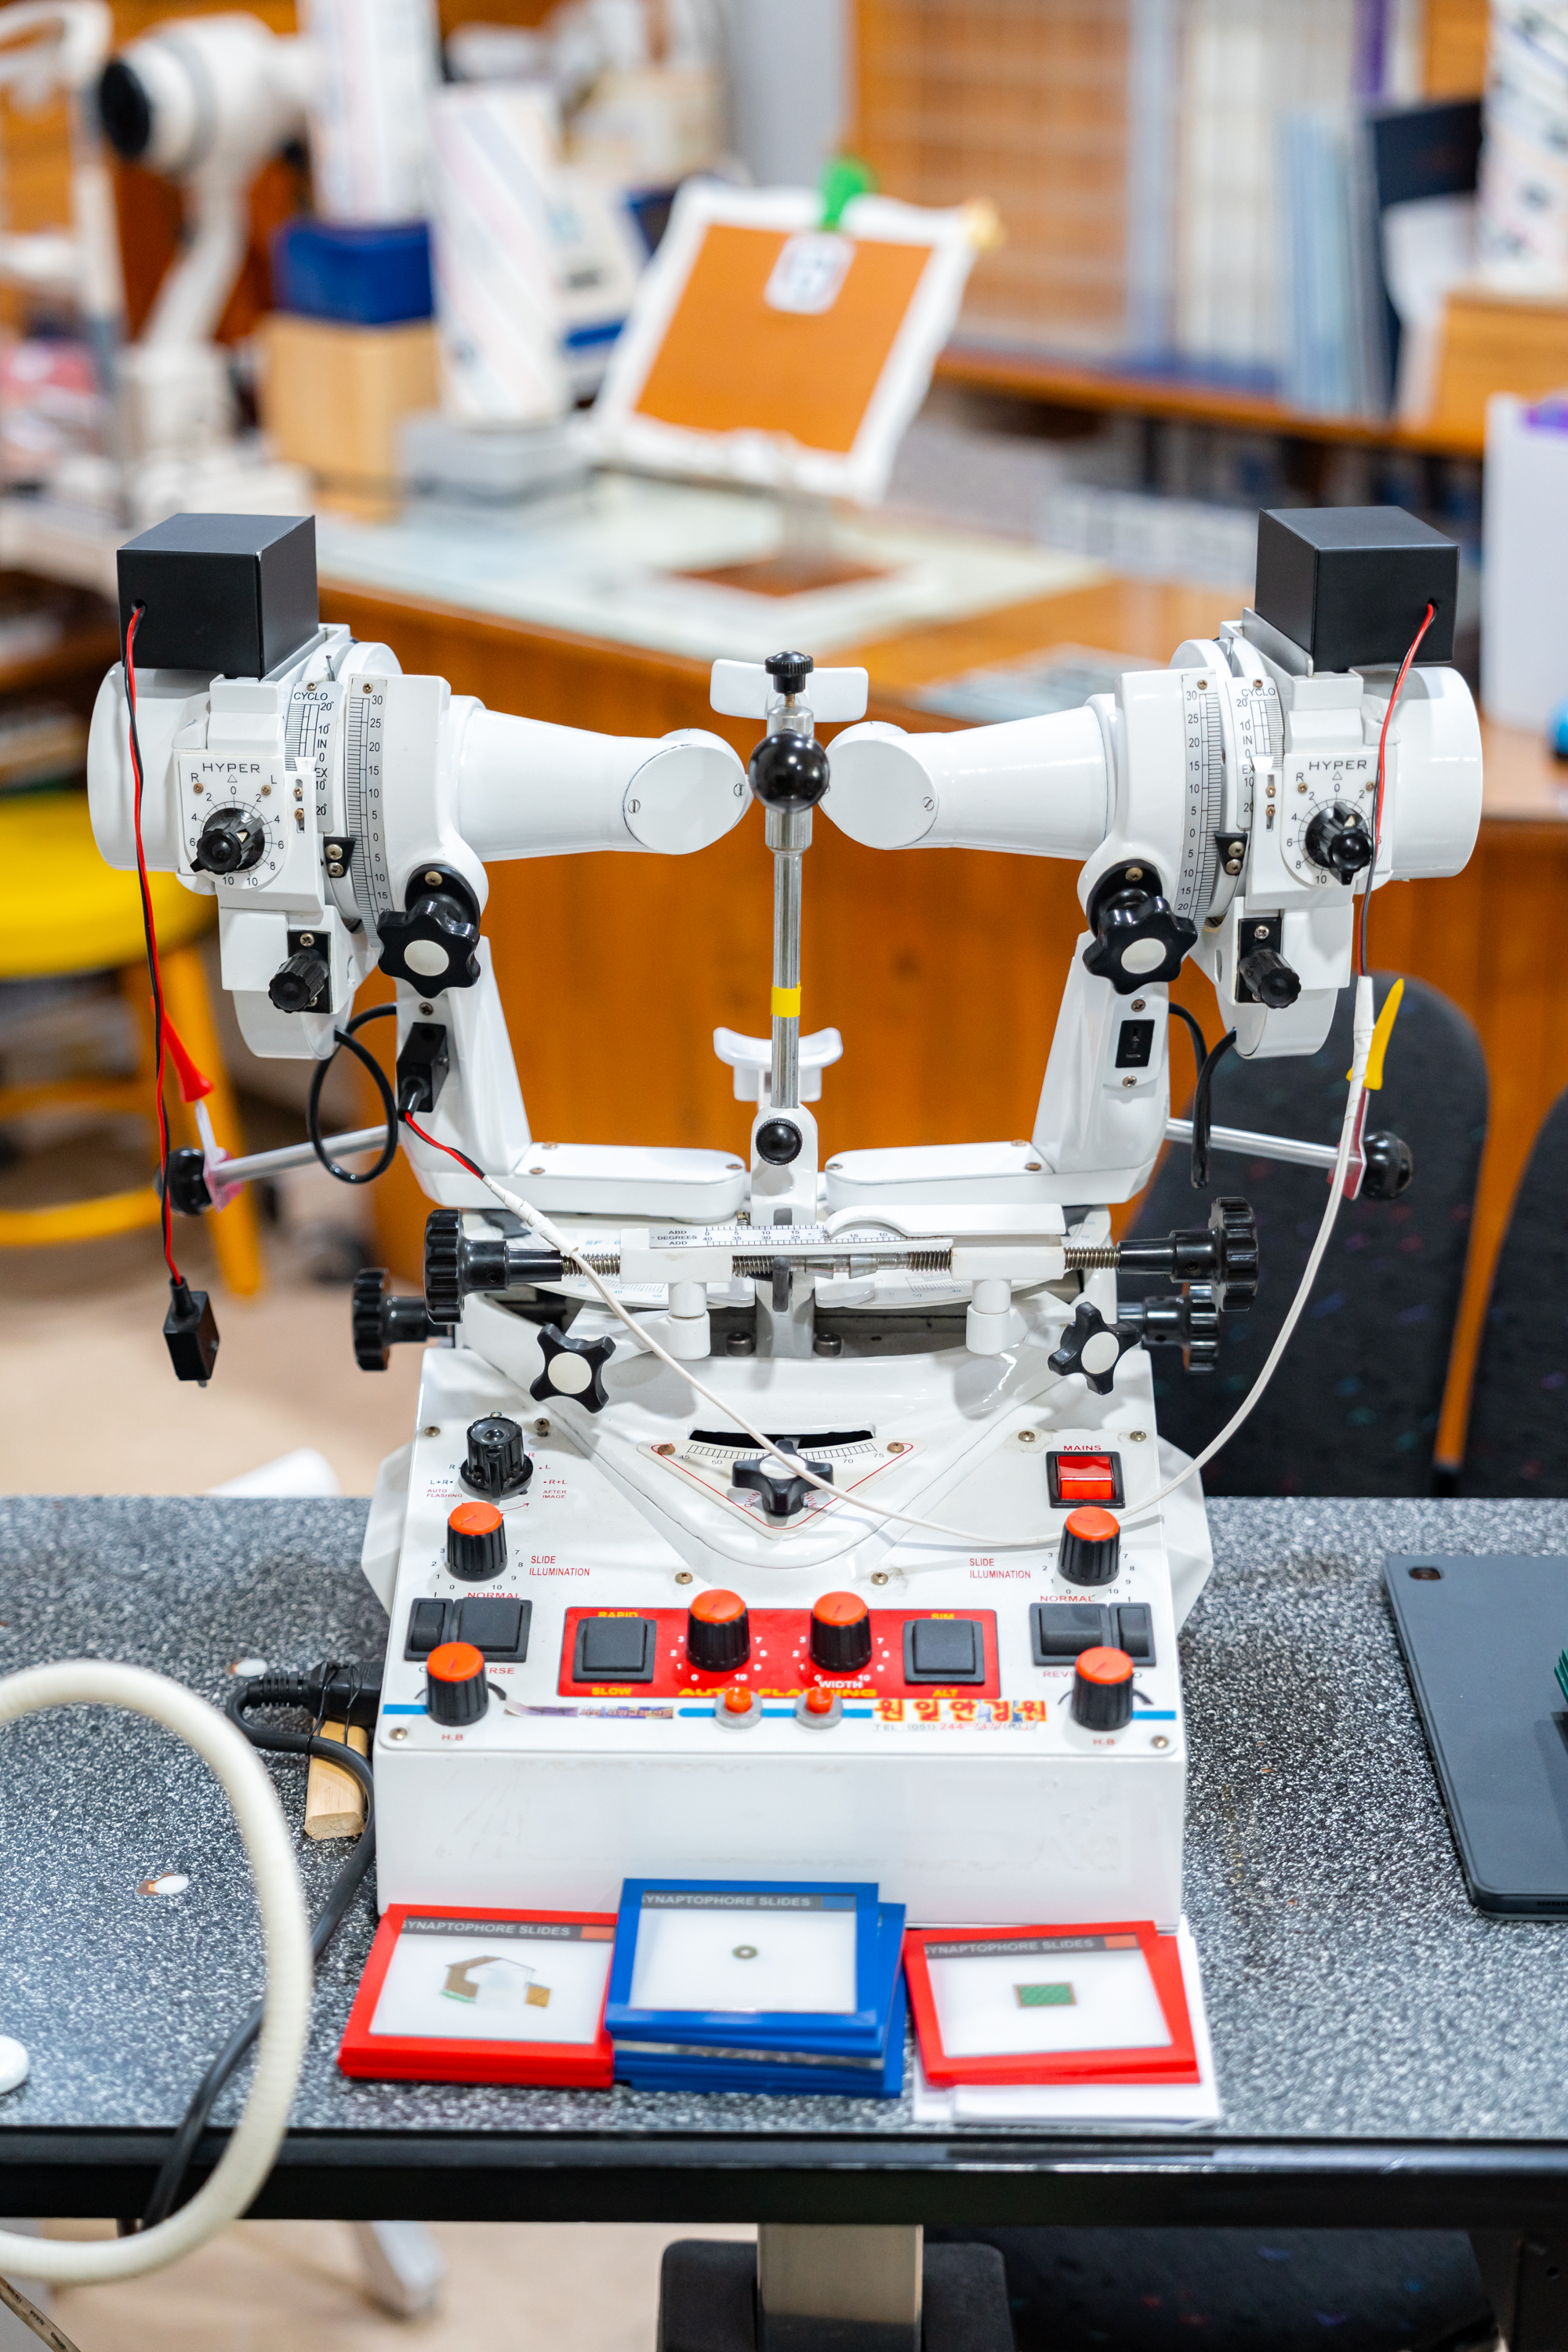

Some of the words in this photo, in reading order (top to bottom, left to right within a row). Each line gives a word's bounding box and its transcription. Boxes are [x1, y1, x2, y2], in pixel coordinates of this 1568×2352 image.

[293, 691, 328, 701] CYCLO
[1186, 691, 1196, 701] 30
[1241, 688, 1276, 698] CYCLO
[372, 695, 383, 705] 30
[369, 718, 381, 728] 25
[1188, 713, 1199, 724] 25
[317, 739, 327, 749] IN
[1189, 738, 1200, 747] 20
[1243, 735, 1252, 746] IN
[368, 742, 380, 752] 20
[319, 753, 325, 762] 0
[1245, 749, 1250, 758] 0
[202, 763, 260, 773] HYPER
[1189, 761, 1200, 771] 15
[1242, 764, 1255, 774] EX
[1309, 760, 1367, 771] HYPER
[315, 768, 328, 778] EX
[368, 766, 379, 775] 15
[191, 773, 199, 783] R
[270, 775, 278, 784] L
[1296, 772, 1304, 782] R
[230, 786, 237, 796] 0
[1189, 784, 1200, 793] 10
[1334, 784, 1341, 793] 0
[206, 793, 212, 802] 2
[256, 793, 262, 803] 2
[368, 789, 379, 798] 10
[1308, 792, 1315, 800] 2
[1359, 789, 1365, 799] 2
[372, 811, 377, 820] 5
[1191, 807, 1196, 815] 5
[191, 813, 197, 822] 4
[1291, 813, 1298, 822] 4
[372, 833, 379, 842] 0
[1189, 829, 1196, 838] 0
[190, 837, 196, 847] 6
[278, 840, 284, 850] 6
[1287, 838, 1293, 847] 6
[375, 853, 380, 862] 5
[1188, 849, 1193, 858] 5
[270, 862, 276, 871] 8
[1295, 860, 1301, 869] 8
[374, 873, 385, 882] 10
[1183, 869, 1194, 877] 10
[223, 877, 234, 886] 10
[246, 877, 258, 887] 10
[1315, 874, 1327, 884] 10
[1181, 886, 1191, 895] 15
[1178, 902, 1189, 911] 20
[744, 1491, 761, 1508] CHIN
[804, 1492, 817, 1507] OWN
[531, 1555, 556, 1564] SLIDE
[969, 1558, 995, 1566] SLIDE
[969, 1570, 1031, 1579] ILLUMINATION
[591, 1687, 632, 1696] SLOW
[758, 1688, 877, 1697] FLAING
[873, 1699, 1047, 1722] 원일안경원
[759, 1896, 811, 1907] SLIDES
[519, 1926, 570, 1936] SLIDES
[1043, 1939, 1094, 1950] SLIDES
